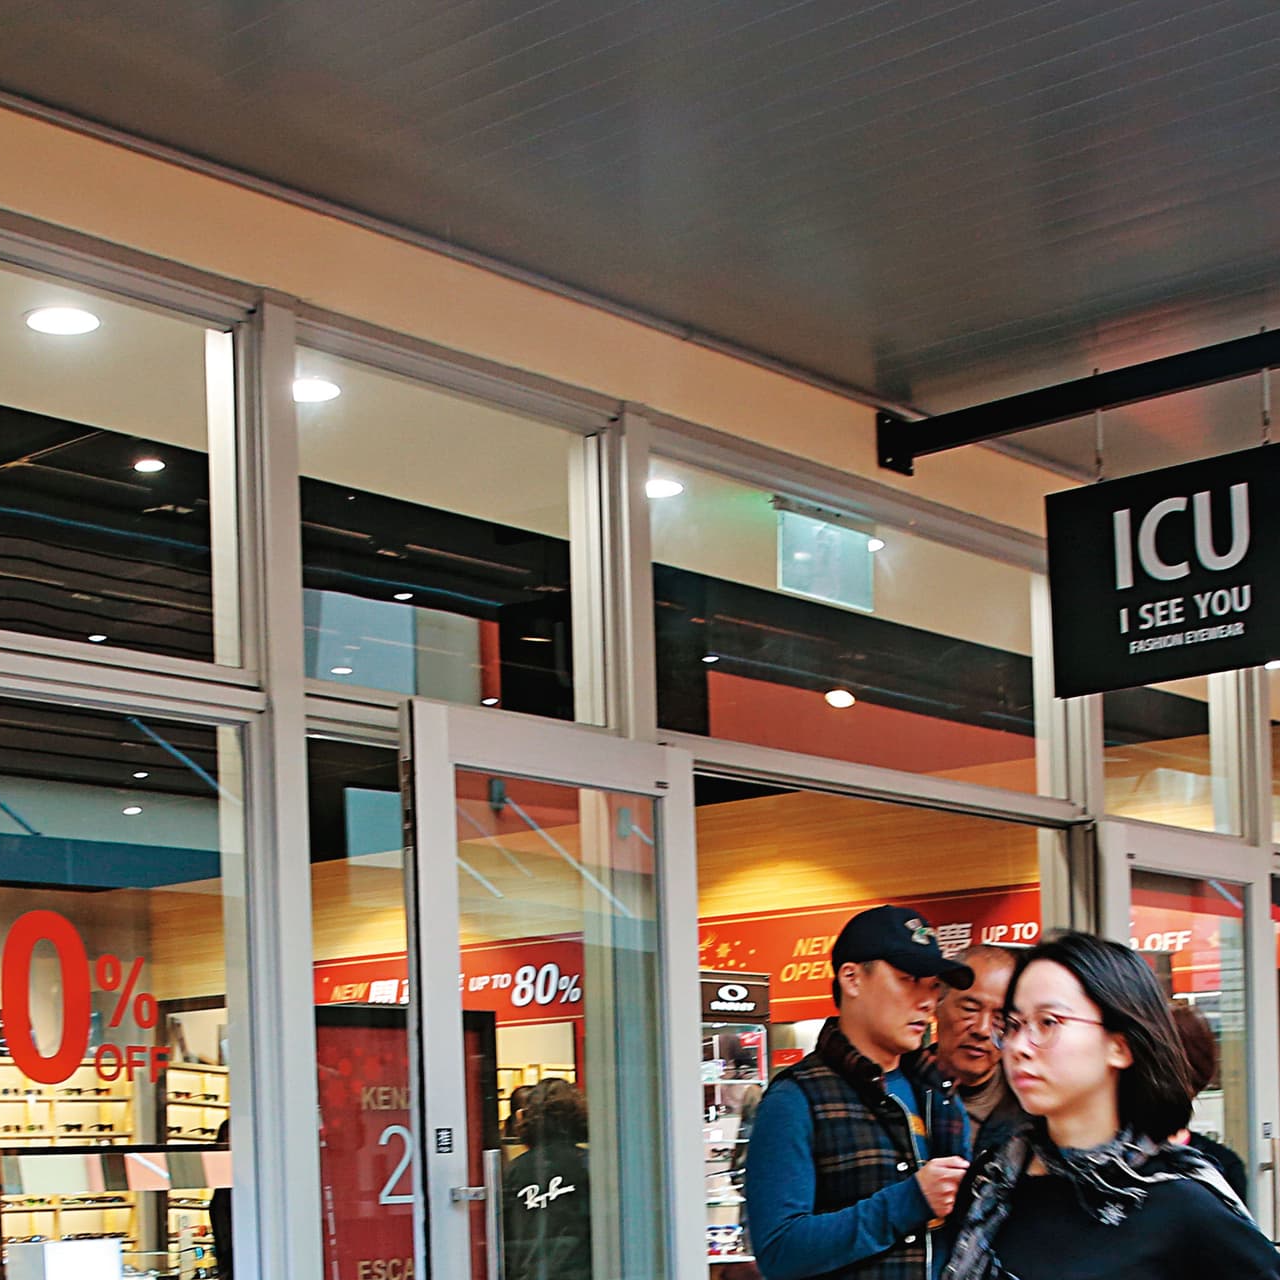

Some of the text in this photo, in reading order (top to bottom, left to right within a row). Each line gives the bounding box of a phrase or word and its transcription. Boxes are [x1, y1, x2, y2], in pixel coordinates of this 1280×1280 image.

[1113, 482, 1251, 590] ICU
[1120, 584, 1252, 634] I SEE YOU
[1129, 622, 1245, 655] FASHION EYEWEAR
[981, 922, 1039, 944] UP TO
[1143, 930, 1193, 952] OFF
[468, 963, 582, 1007] UP TO 80%
[95, 1043, 170, 1083] OFF
[378, 1124, 414, 1205] 2
